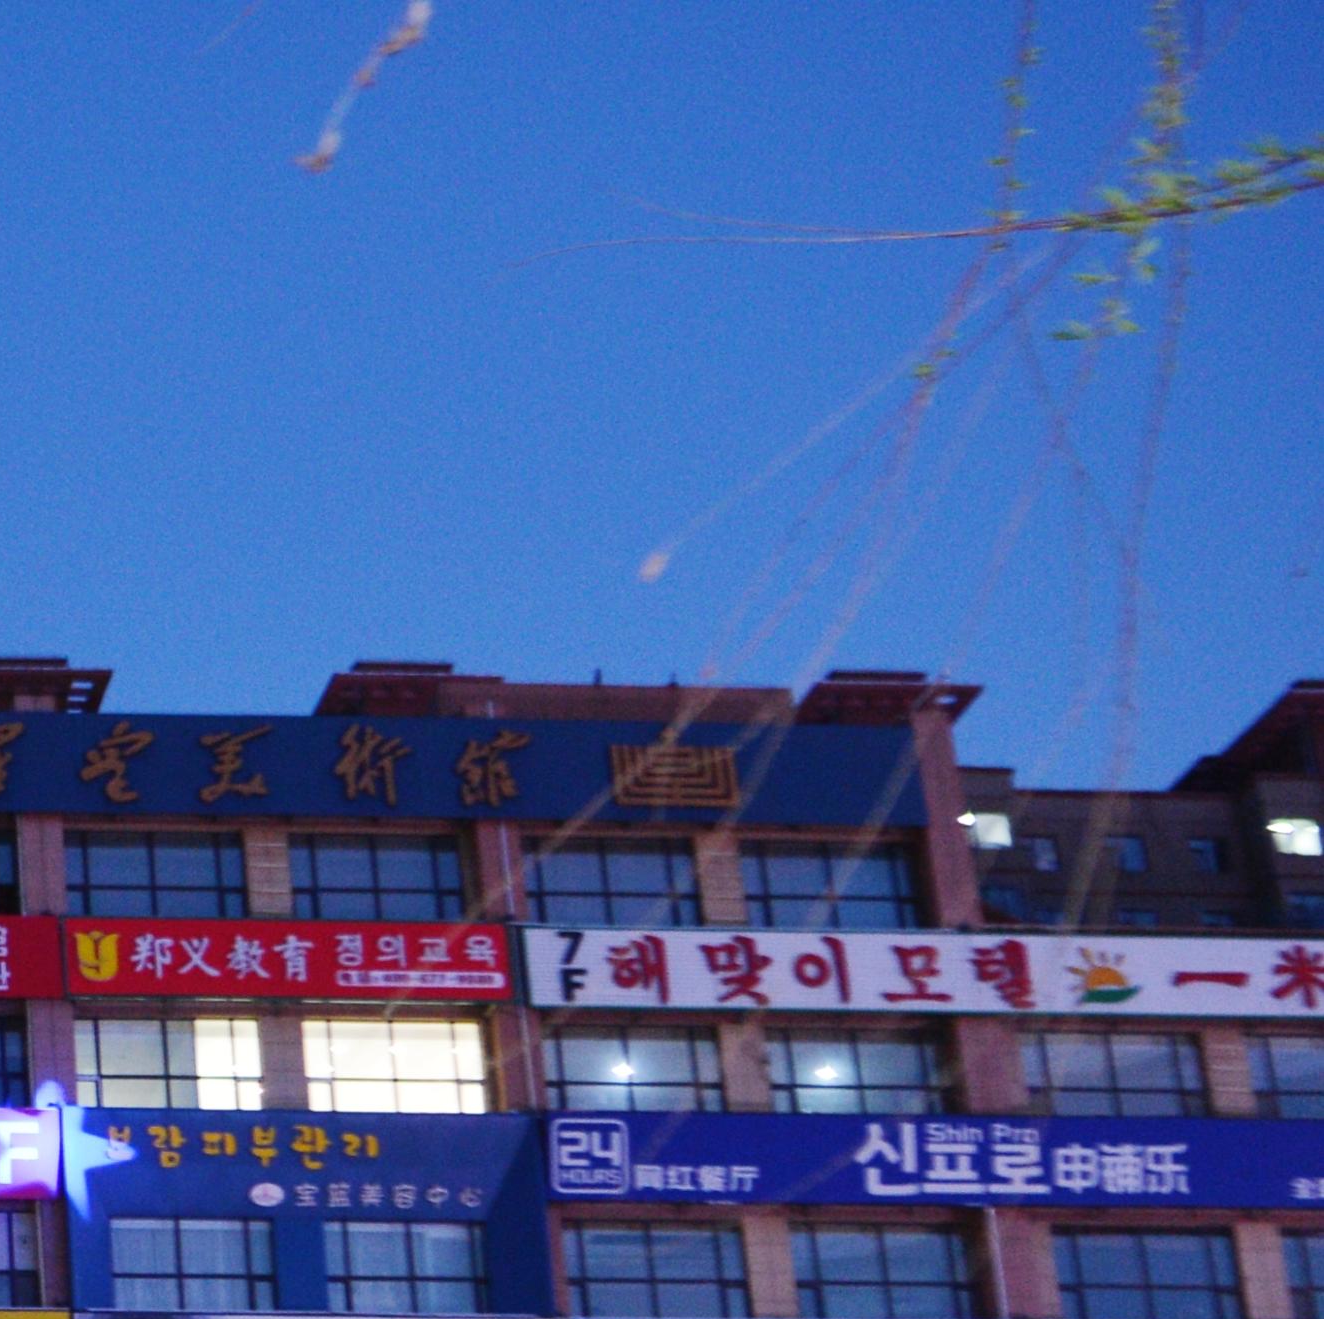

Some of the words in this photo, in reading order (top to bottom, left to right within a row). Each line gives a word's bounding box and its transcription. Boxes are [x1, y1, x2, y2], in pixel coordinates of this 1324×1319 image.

[129, 933, 315, 982] 郑义教育
[557, 1128, 623, 1167] 24
[853, 1120, 1052, 1197] 신프로
[633, 1164, 759, 1193] 网红餐厅
